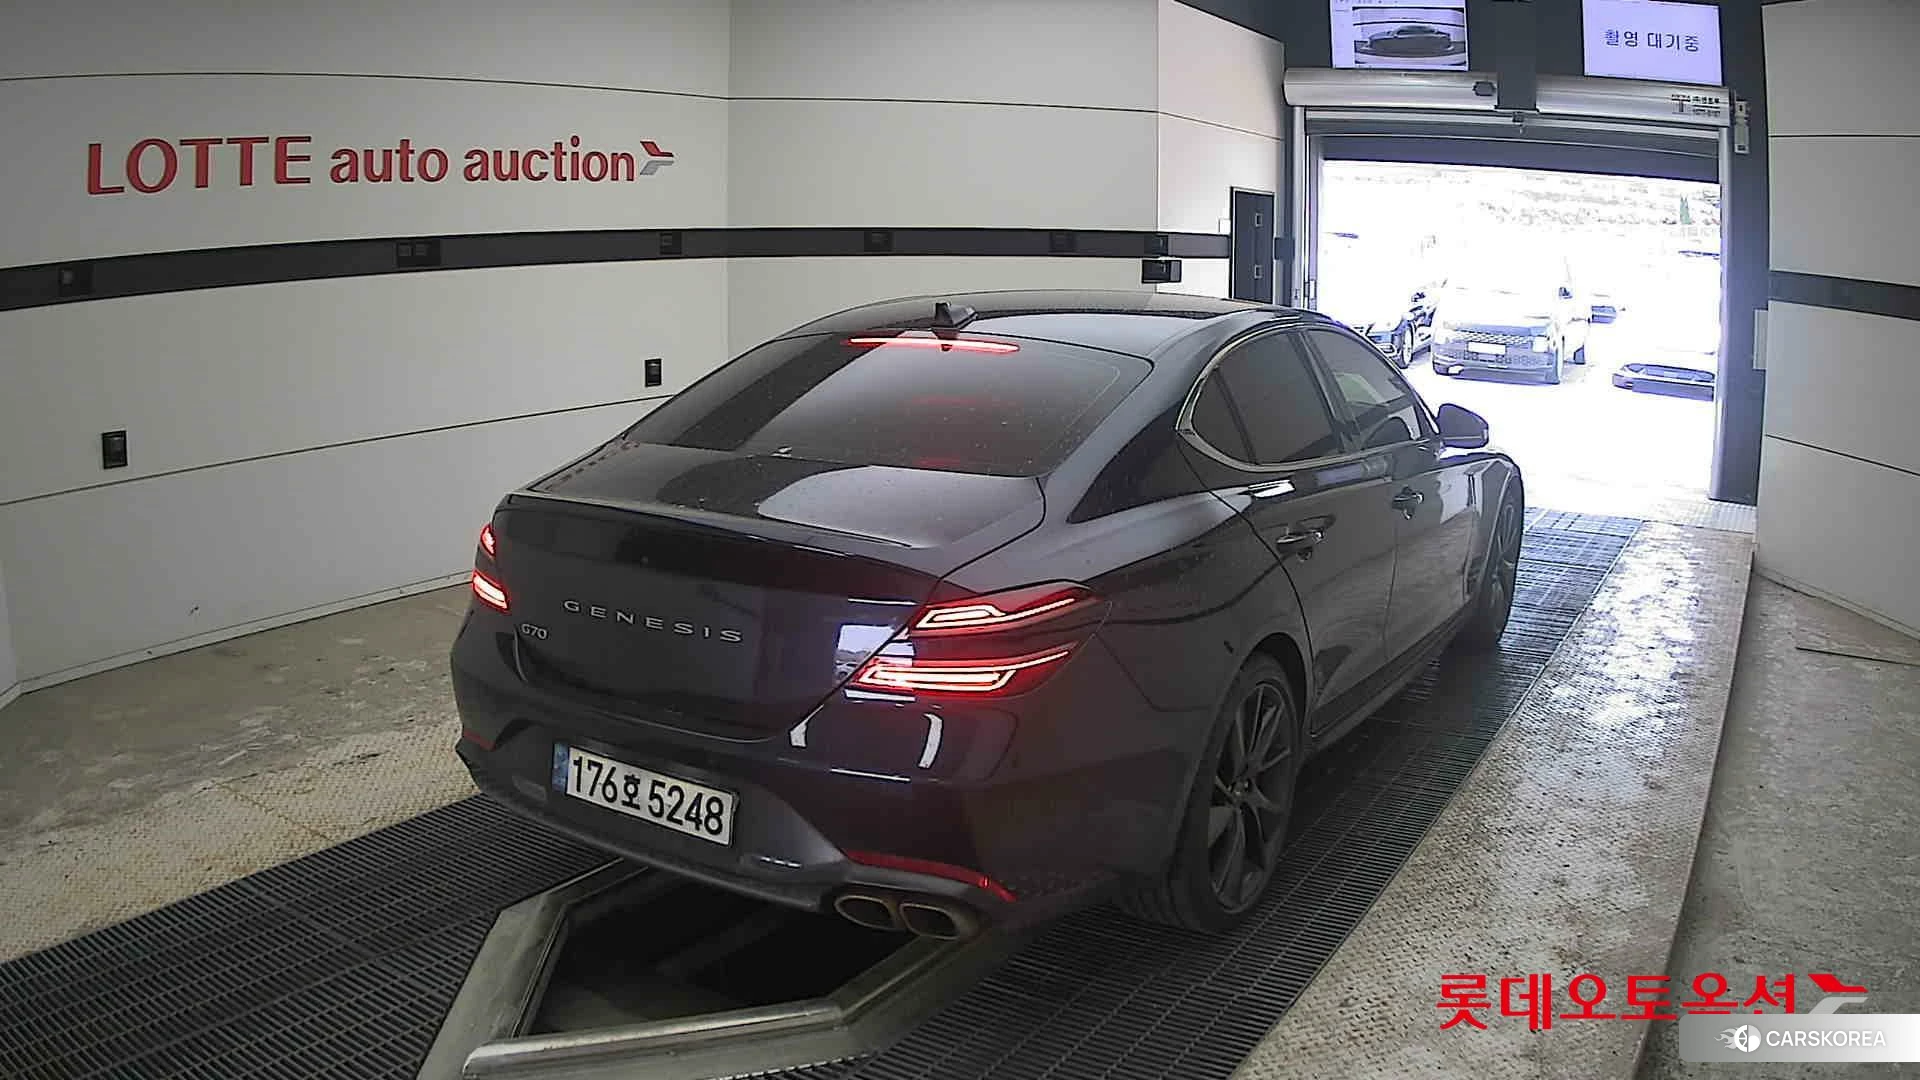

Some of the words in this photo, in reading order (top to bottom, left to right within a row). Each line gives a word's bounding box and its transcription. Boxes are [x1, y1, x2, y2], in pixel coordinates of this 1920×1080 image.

[1647, 33, 1699, 52] 대기중
[87, 136, 312, 195] LOTTE
[329, 138, 449, 183] auto
[463, 135, 634, 182] auction
[520, 623, 548, 640] G70
[563, 600, 742, 642] GENESIS
[648, 779, 724, 836] 5248
